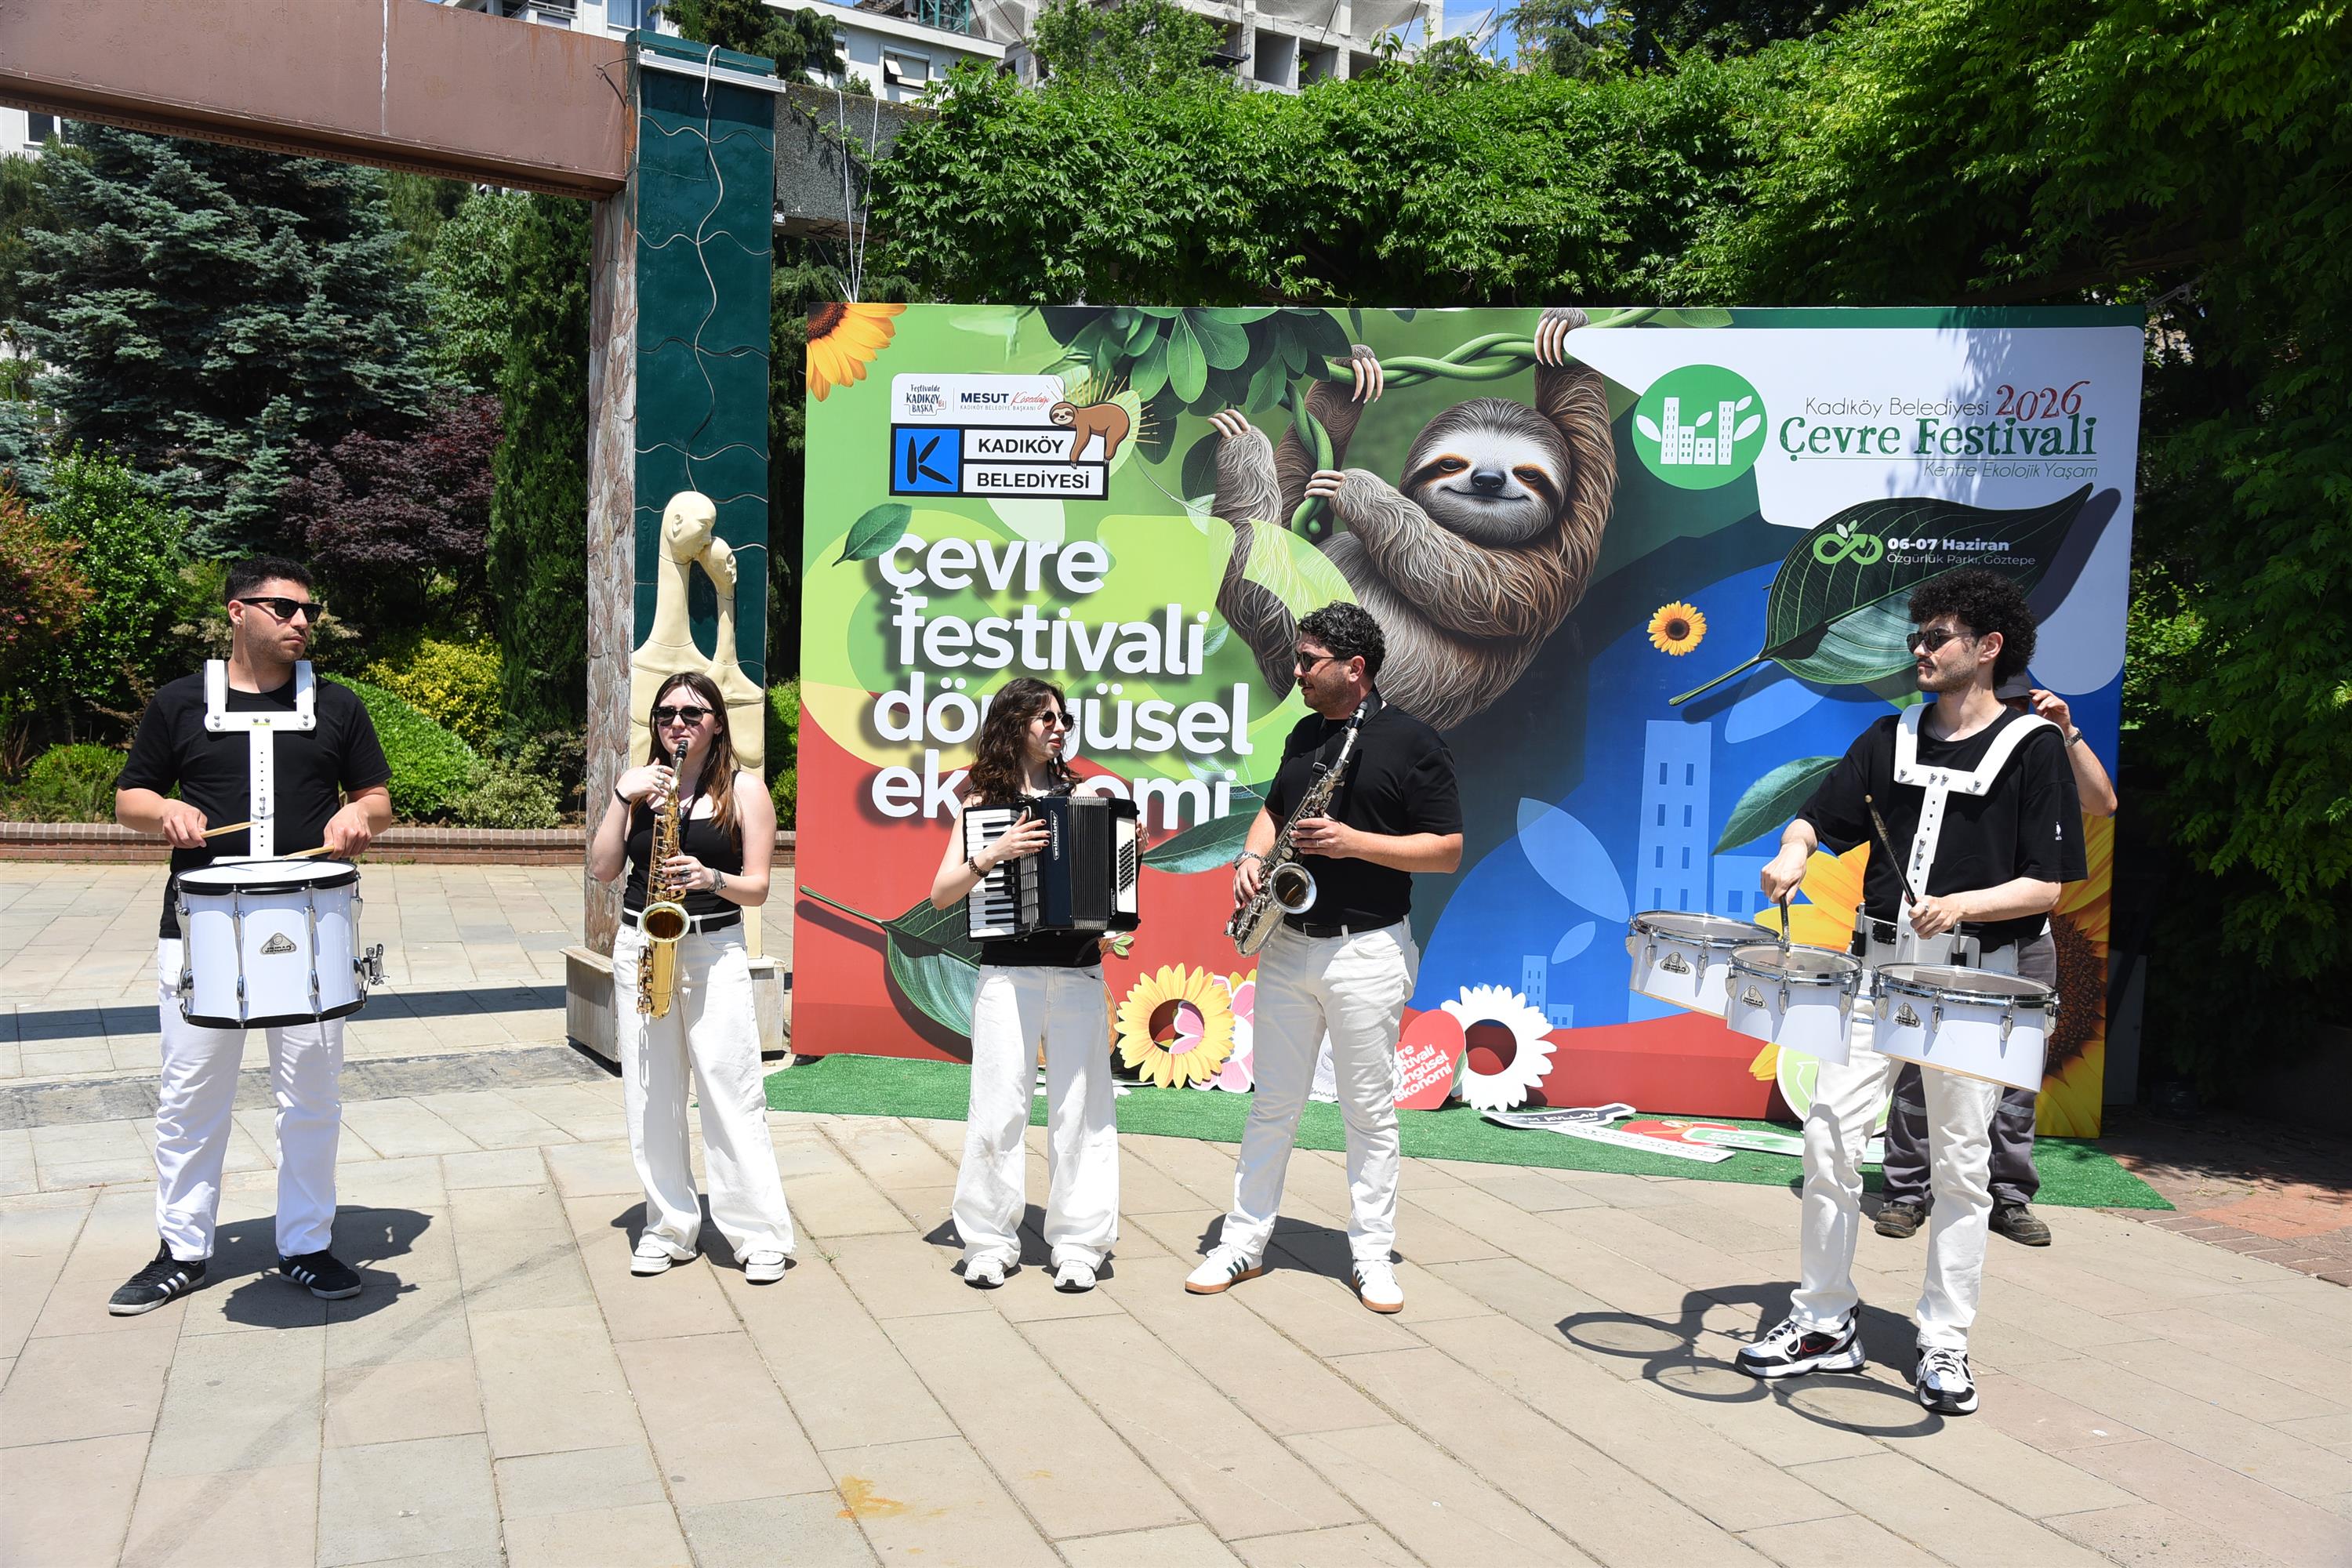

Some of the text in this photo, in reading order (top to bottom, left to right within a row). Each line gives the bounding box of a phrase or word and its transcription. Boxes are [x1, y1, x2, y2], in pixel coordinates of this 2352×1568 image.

[960, 393, 1009, 403] MESUT
[1806, 381, 2091, 422] Kadıköy Belediyesi 2026
[912, 404, 934, 414] BAŞKA
[978, 436, 1065, 454] KADIKÖY
[1779, 413, 2097, 462] Çevre Festivali
[977, 470, 1090, 489] BELEDİYESİ
[1982, 463, 2040, 479] Ekolojik
[2044, 463, 2098, 481] Yaşam
[1887, 538, 2009, 551] 06-07 Haziran
[878, 533, 1109, 604] çevre
[1886, 552, 2036, 567] Özgürlük Parkı, Göztepe
[892, 593, 1210, 675] festivali
[873, 671, 1254, 762] döüsel
